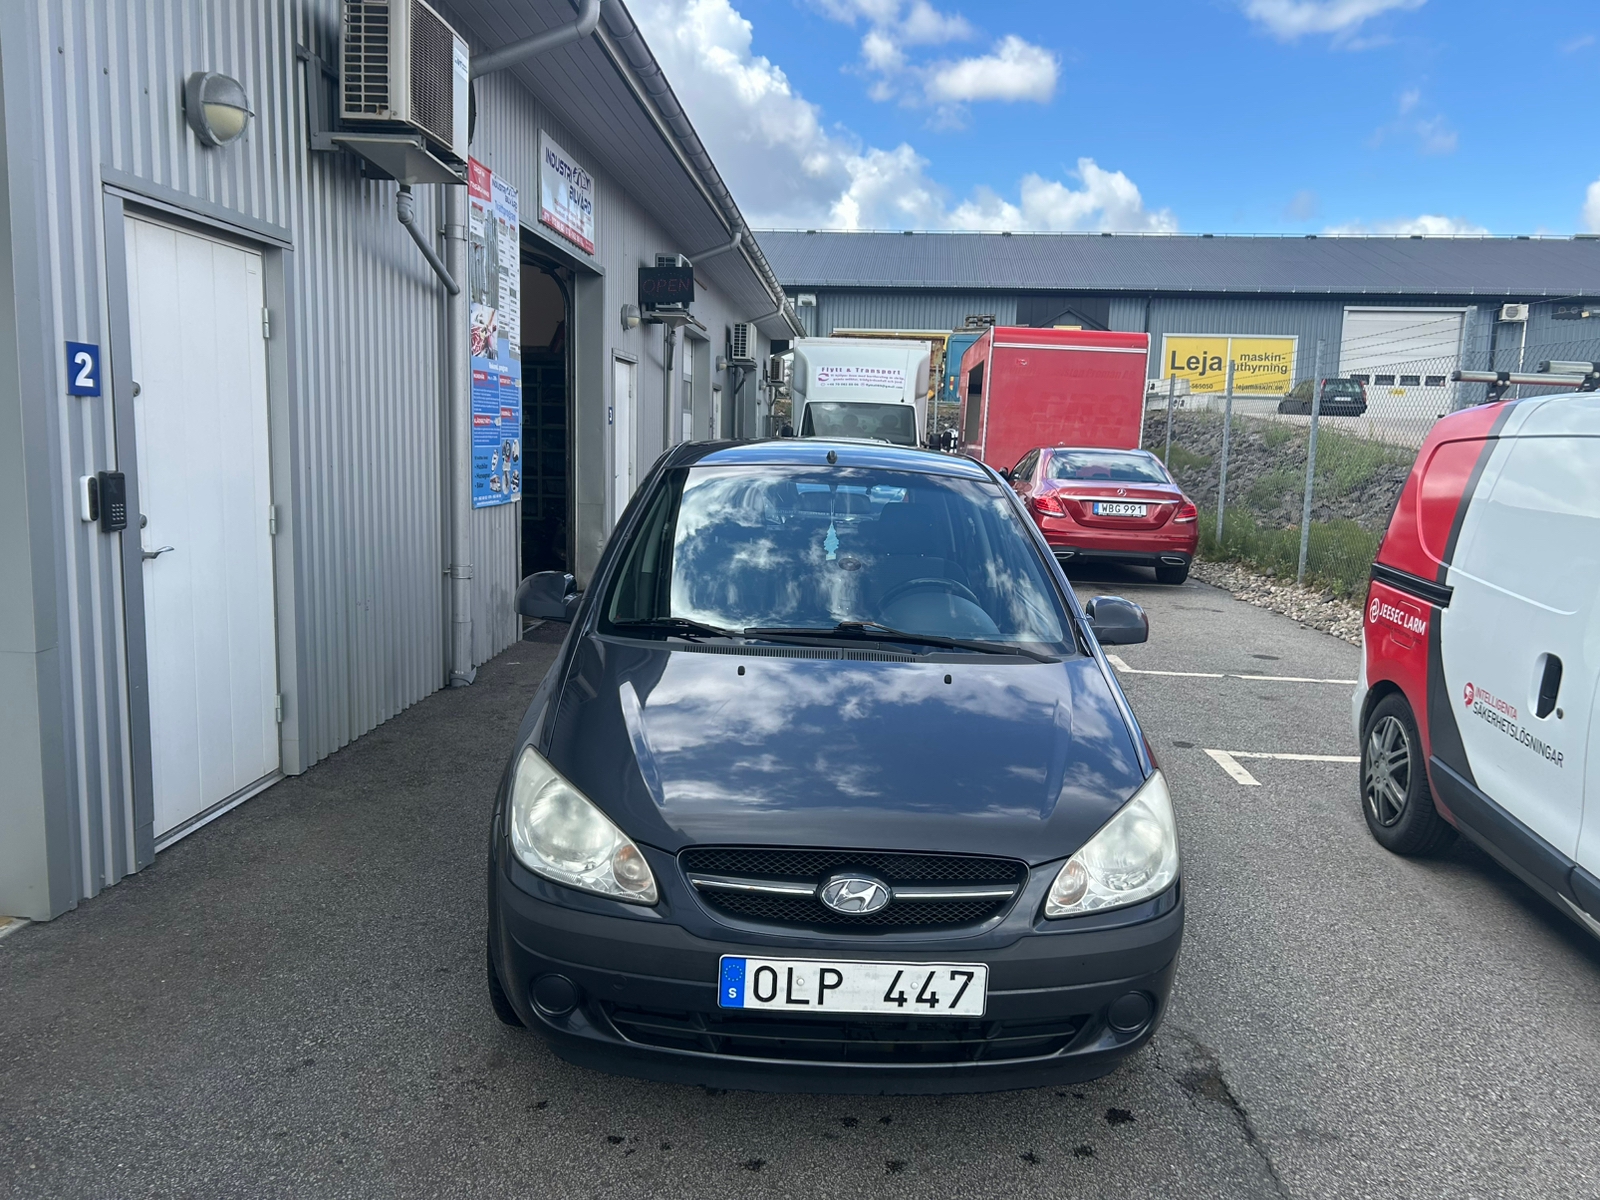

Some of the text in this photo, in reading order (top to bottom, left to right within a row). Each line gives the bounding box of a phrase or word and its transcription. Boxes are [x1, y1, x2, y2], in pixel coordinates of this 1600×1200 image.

[545, 147, 573, 183] INDUSTRI
[492, 178, 507, 194] INDUSTRI
[569, 184, 592, 215] BILVÅRD
[642, 278, 691, 293] OPEN
[73, 351, 94, 387] 2
[855, 367, 901, 375] Transport
[1170, 350, 1223, 376] Leja
[1234, 362, 1288, 374] uthyrning
[1239, 352, 1286, 362] maskin-
[1102, 504, 1142, 514] WBG 991
[1379, 602, 1405, 625] JEESEC
[1403, 613, 1426, 636] LARM
[1475, 686, 1518, 720] INTELLIGENTA
[1472, 701, 1565, 768] SÄKERHETSLÖSNINGAR
[728, 965, 975, 1010] S OLP 447
